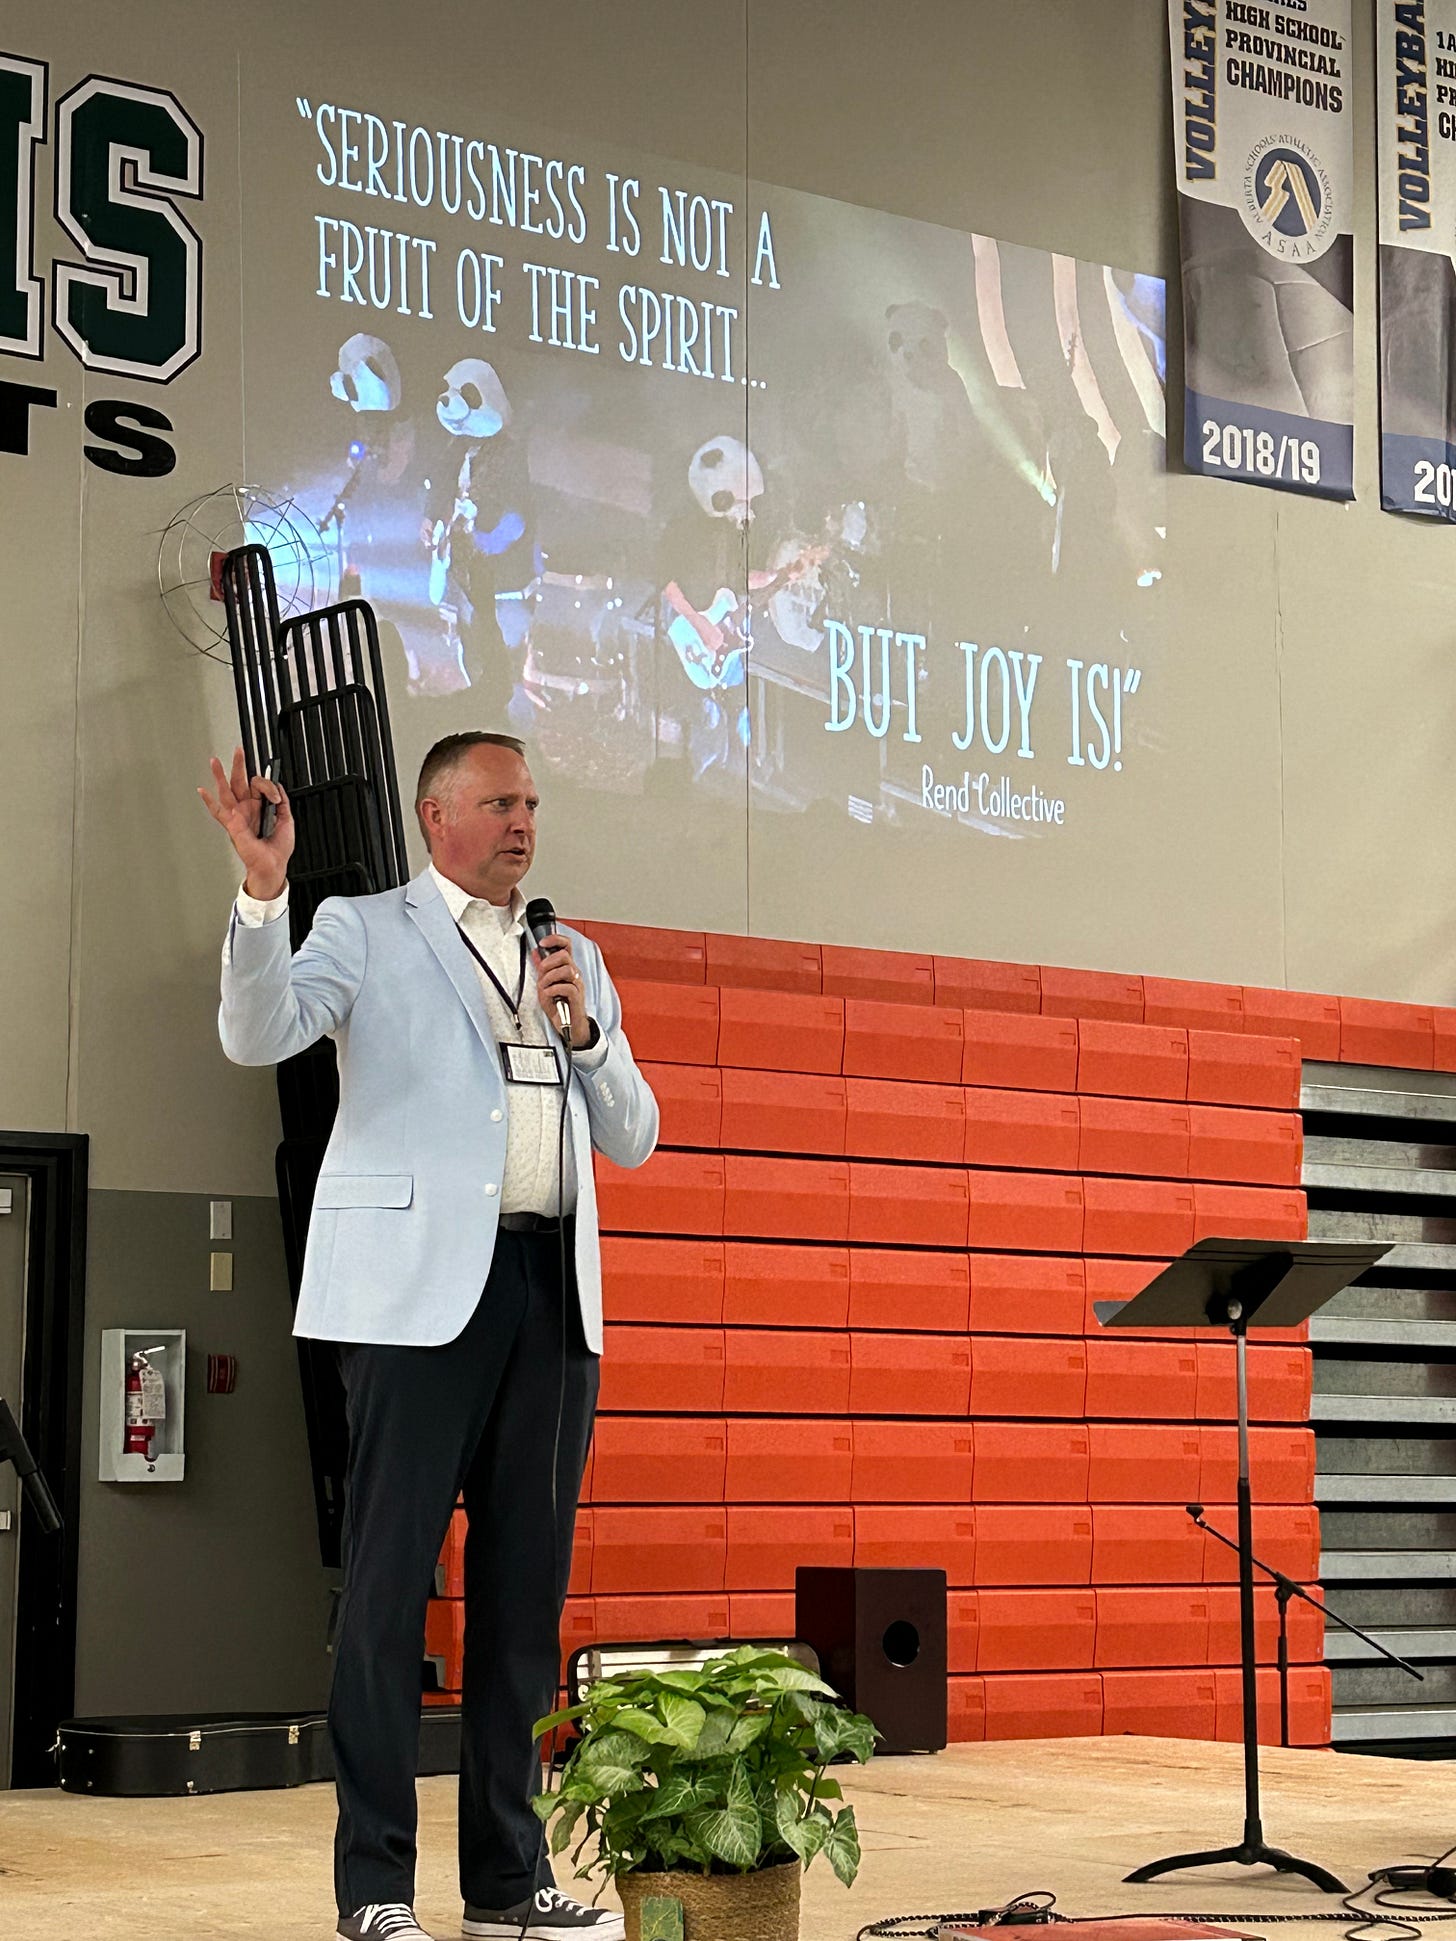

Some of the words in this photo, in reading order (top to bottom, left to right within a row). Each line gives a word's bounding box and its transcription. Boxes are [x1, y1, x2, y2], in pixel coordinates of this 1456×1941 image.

[1225, 0, 1270, 31] HIGH
[1274, 14, 1343, 50] SCHOOL
[1225, 28, 1341, 78] PROVINCIAL
[1226, 57, 1343, 113] CHAMPIONS
[605, 173, 641, 257] IS
[658, 186, 734, 278] NOT
[750, 211, 781, 290] A
[1262, 230, 1316, 257] ASAA
[314, 215, 437, 320] FRUIT
[456, 248, 504, 333] OF
[522, 262, 600, 354] THE
[618, 284, 767, 390] SPIRIT...
[1202, 419, 1321, 485] 2018/19
[823, 619, 926, 743] BUT
[952, 641, 1043, 759] JOY
[921, 764, 970, 813] Rend
[973, 772, 1066, 825] Collective
